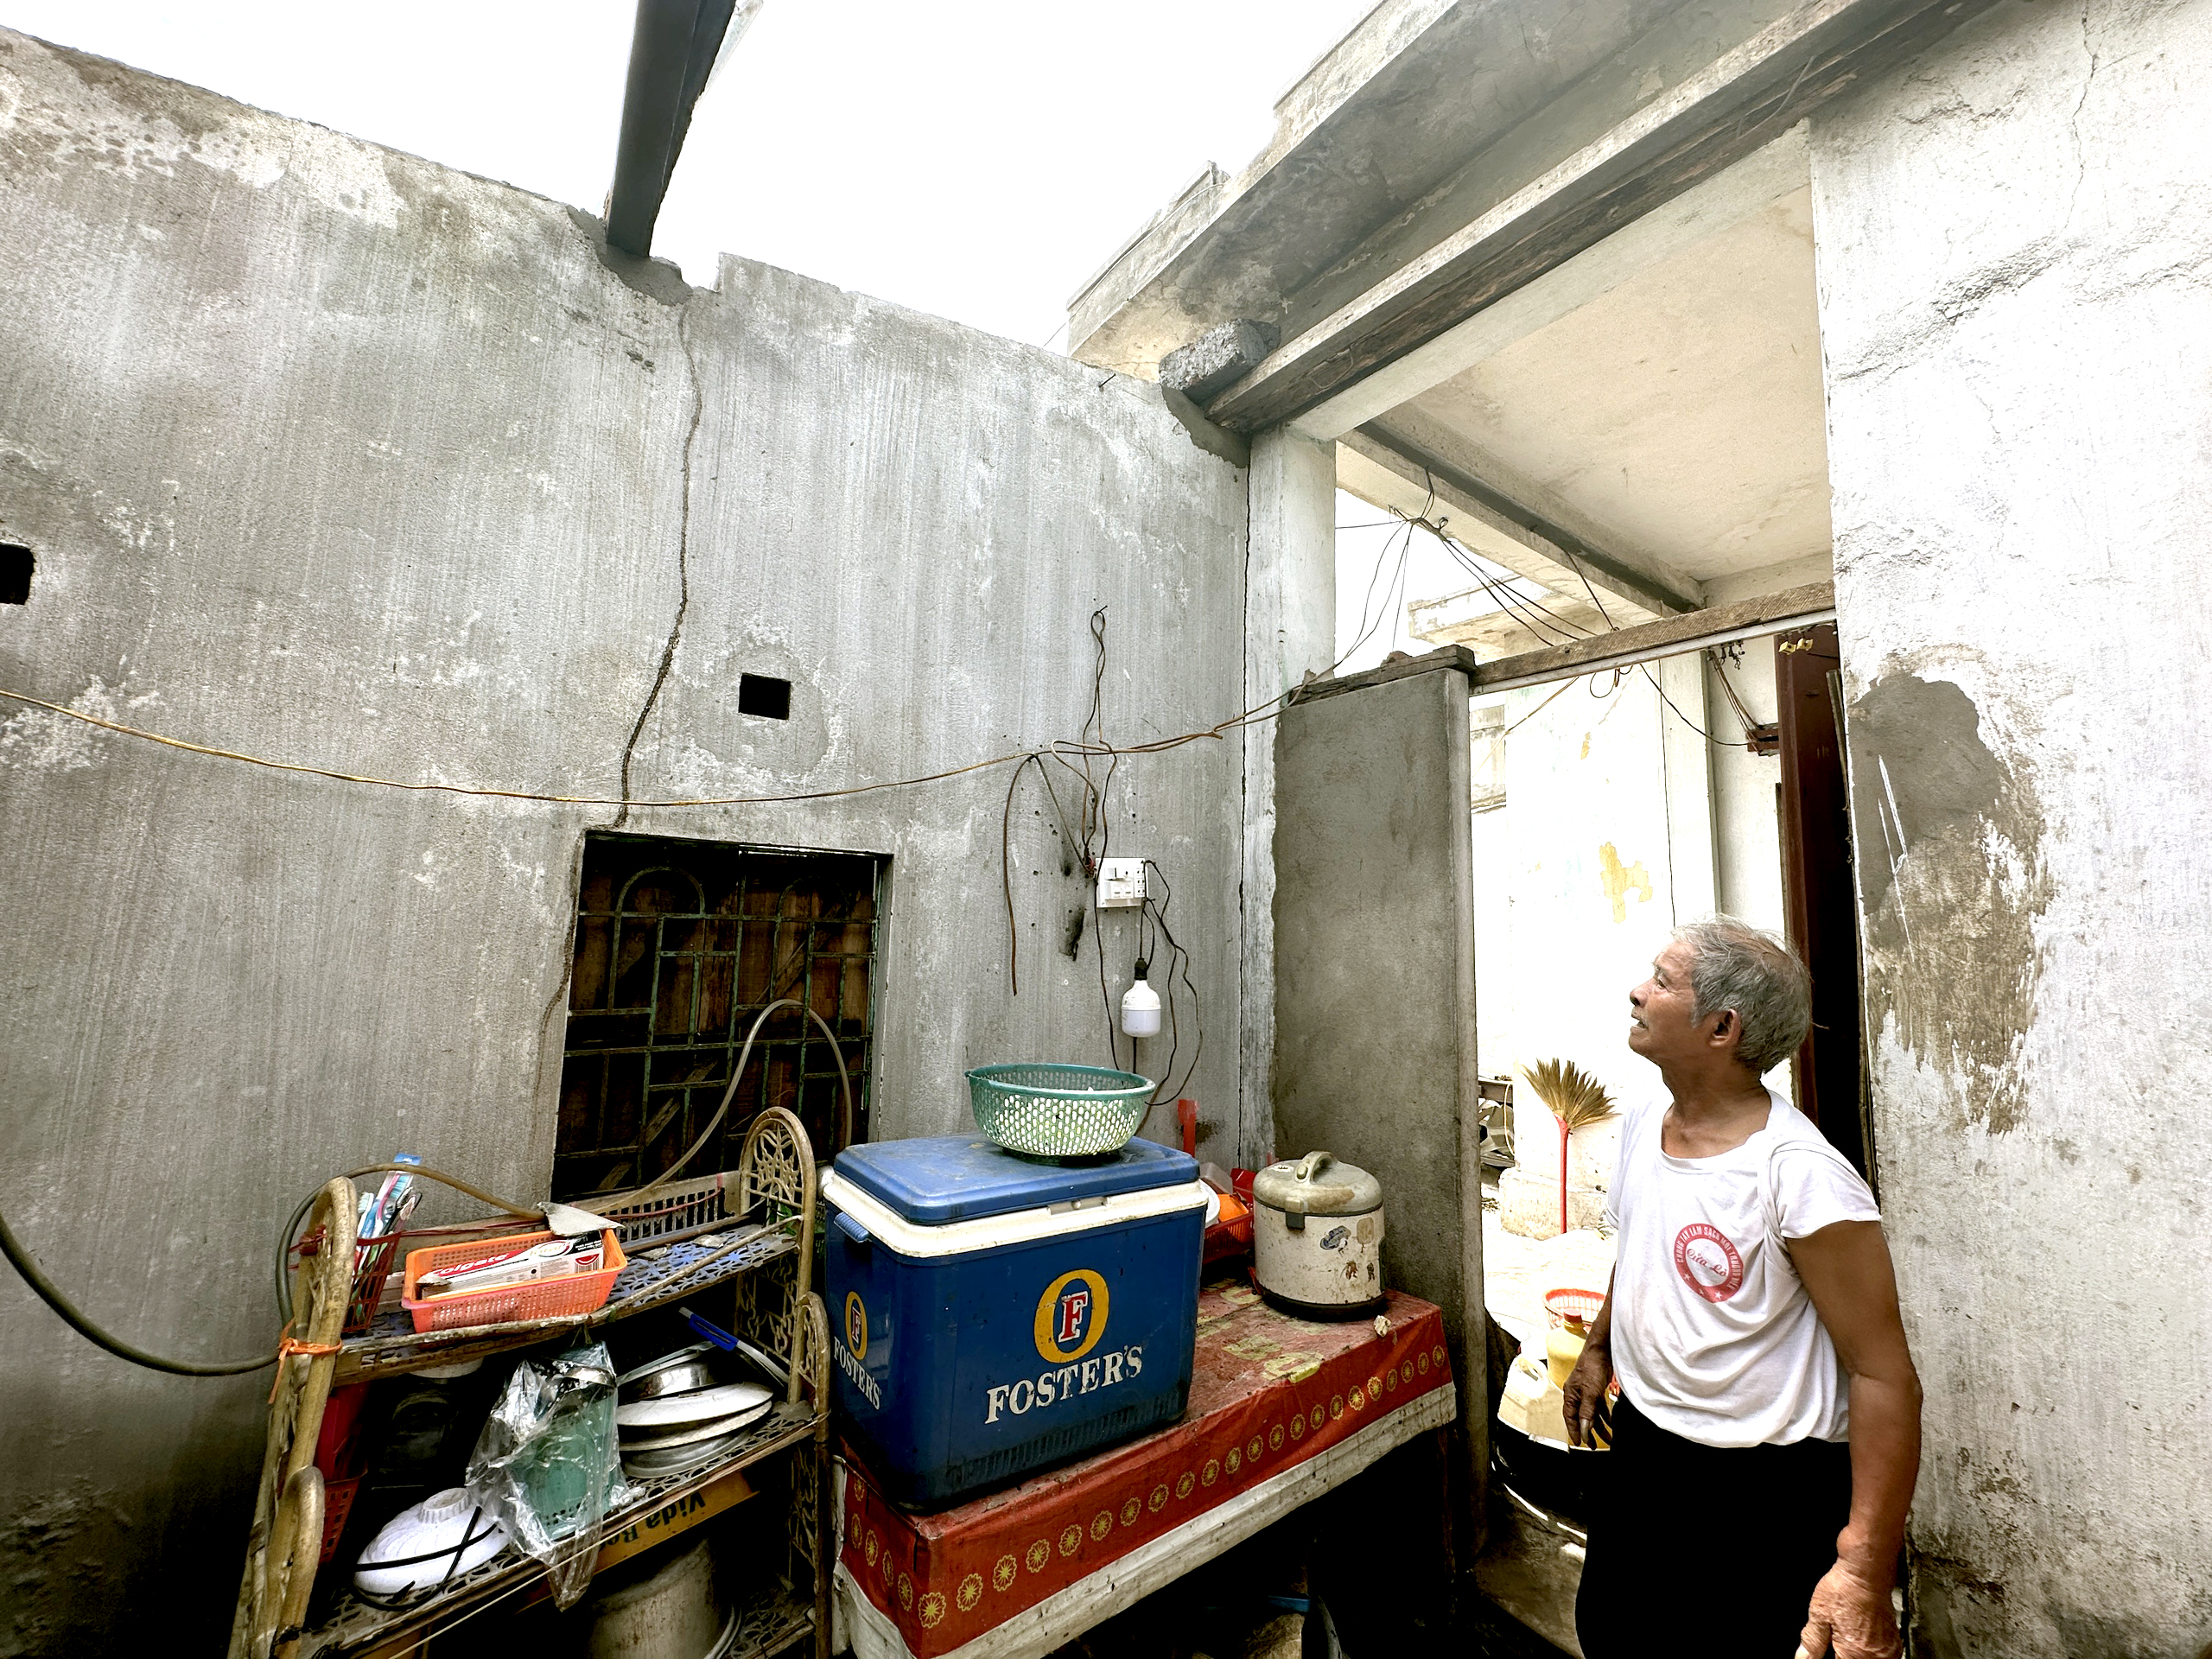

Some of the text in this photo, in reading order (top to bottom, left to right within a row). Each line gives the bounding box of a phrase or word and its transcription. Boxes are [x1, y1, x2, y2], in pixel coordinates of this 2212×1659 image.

[432, 1253, 509, 1275] Colgate
[1680, 1230, 1690, 1243] TAY
[1058, 1291, 1088, 1343] F
[834, 1336, 880, 1410] FOSTER'S
[984, 1344, 1143, 1424] FOSTER'S
[600, 1491, 706, 1551] Vida Ro
